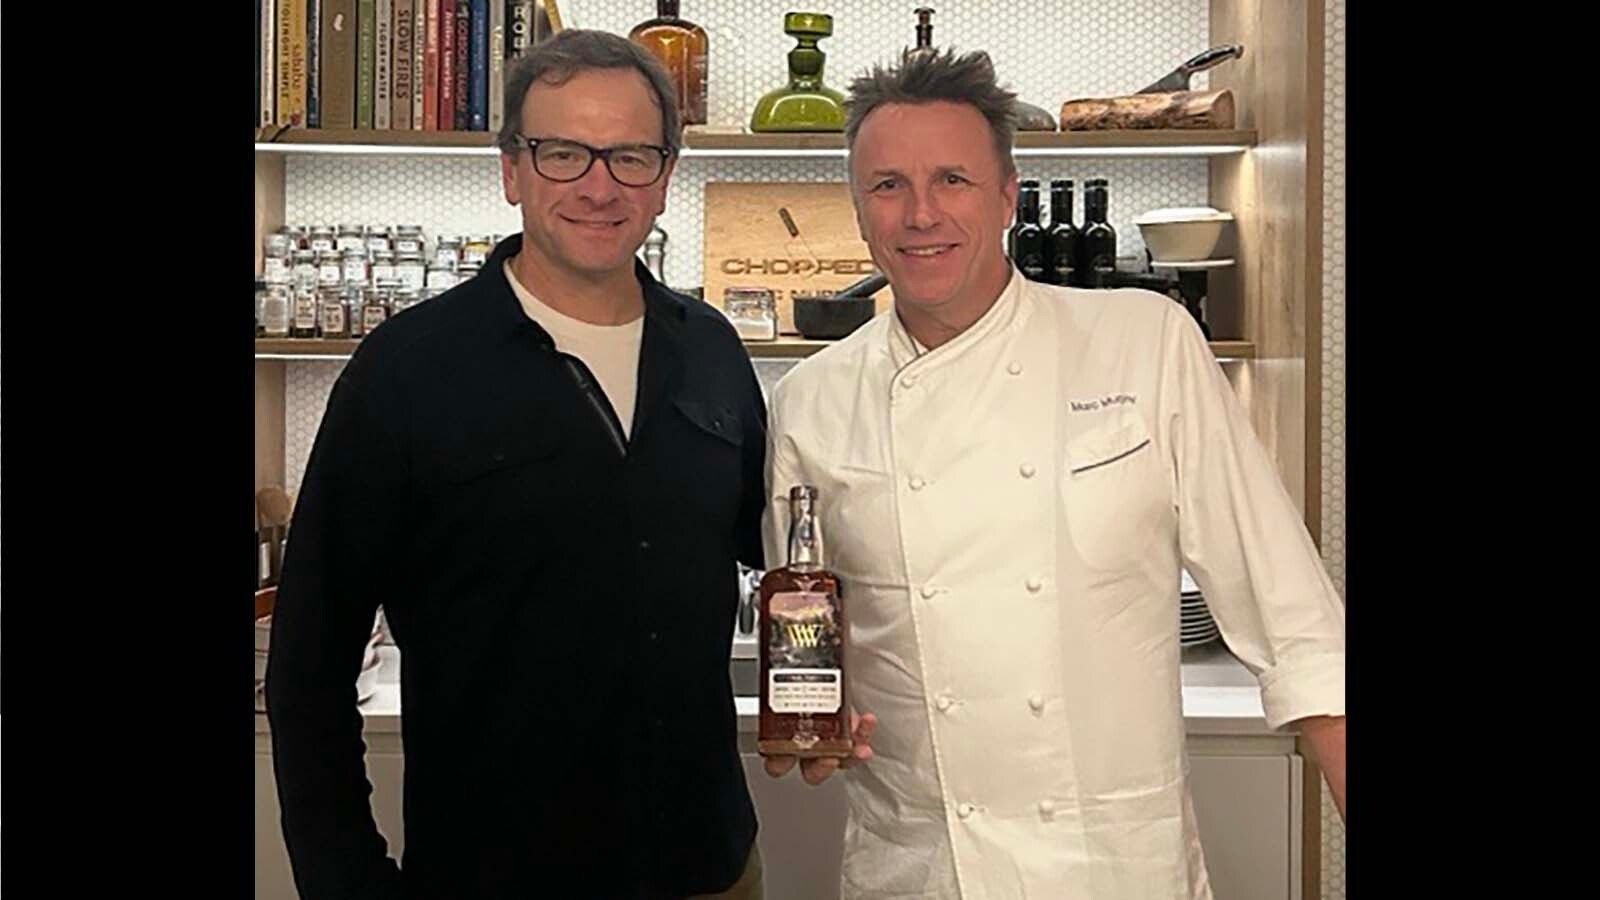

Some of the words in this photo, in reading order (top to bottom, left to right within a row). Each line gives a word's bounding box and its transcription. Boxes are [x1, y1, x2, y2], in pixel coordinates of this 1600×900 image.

[397, 9, 410, 53] SLOW
[379, 65, 387, 100] WATER
[396, 58, 409, 100] FIRES
[721, 258, 874, 275] CHOPPED
